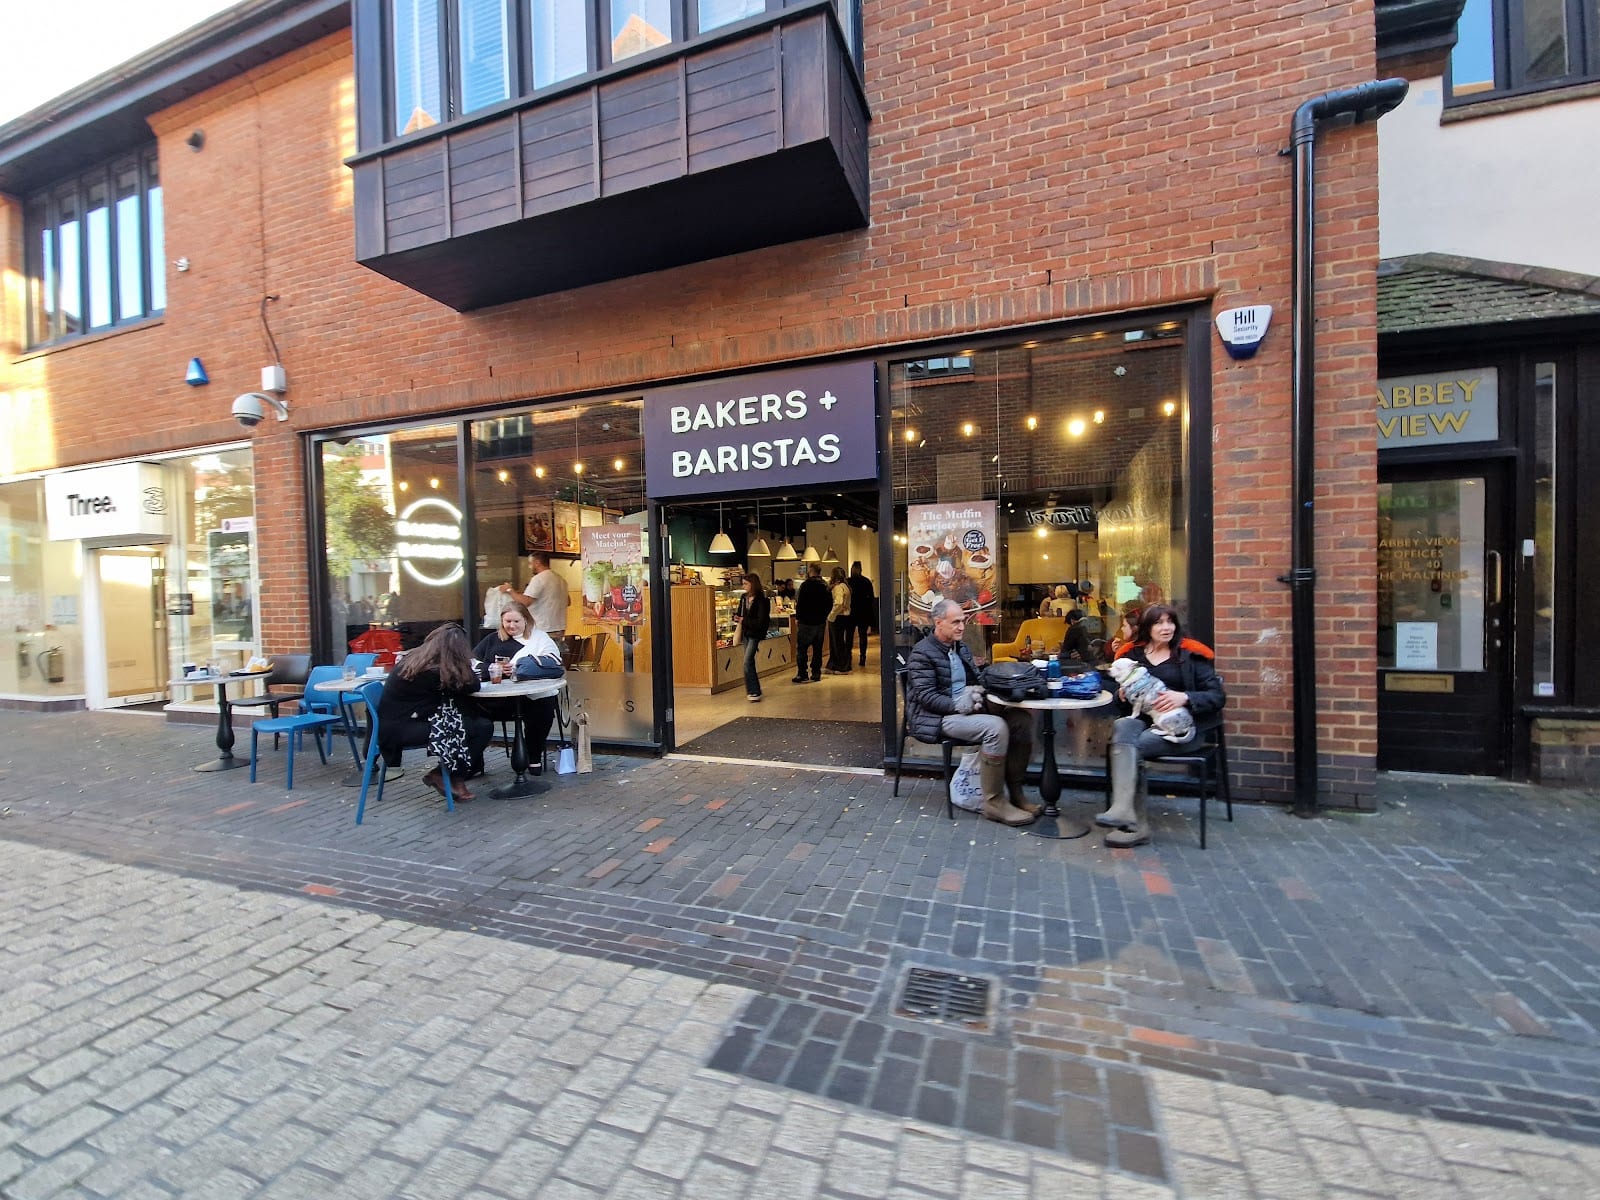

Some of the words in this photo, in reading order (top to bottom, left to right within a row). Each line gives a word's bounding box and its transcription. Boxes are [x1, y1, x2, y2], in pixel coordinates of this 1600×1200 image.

[1234, 309, 1255, 325] Hill
[1377, 378, 1481, 409] ABBEY
[670, 390, 808, 433] BAKERS
[819, 390, 837, 411] +
[1377, 410, 1470, 439] VIEW
[672, 433, 841, 477] BARISTAS
[920, 511, 943, 521] The
[945, 508, 982, 520] Muffin
[919, 521, 958, 533] Variety
[961, 520, 985, 529] Box
[591, 531, 611, 540] Meet
[612, 531, 631, 540] your
[1379, 537, 1420, 548] ABBEY
[1425, 536, 1460, 546] VIEW
[595, 539, 627, 548] Matcha!
[1394, 549, 1444, 559] OFFICES
